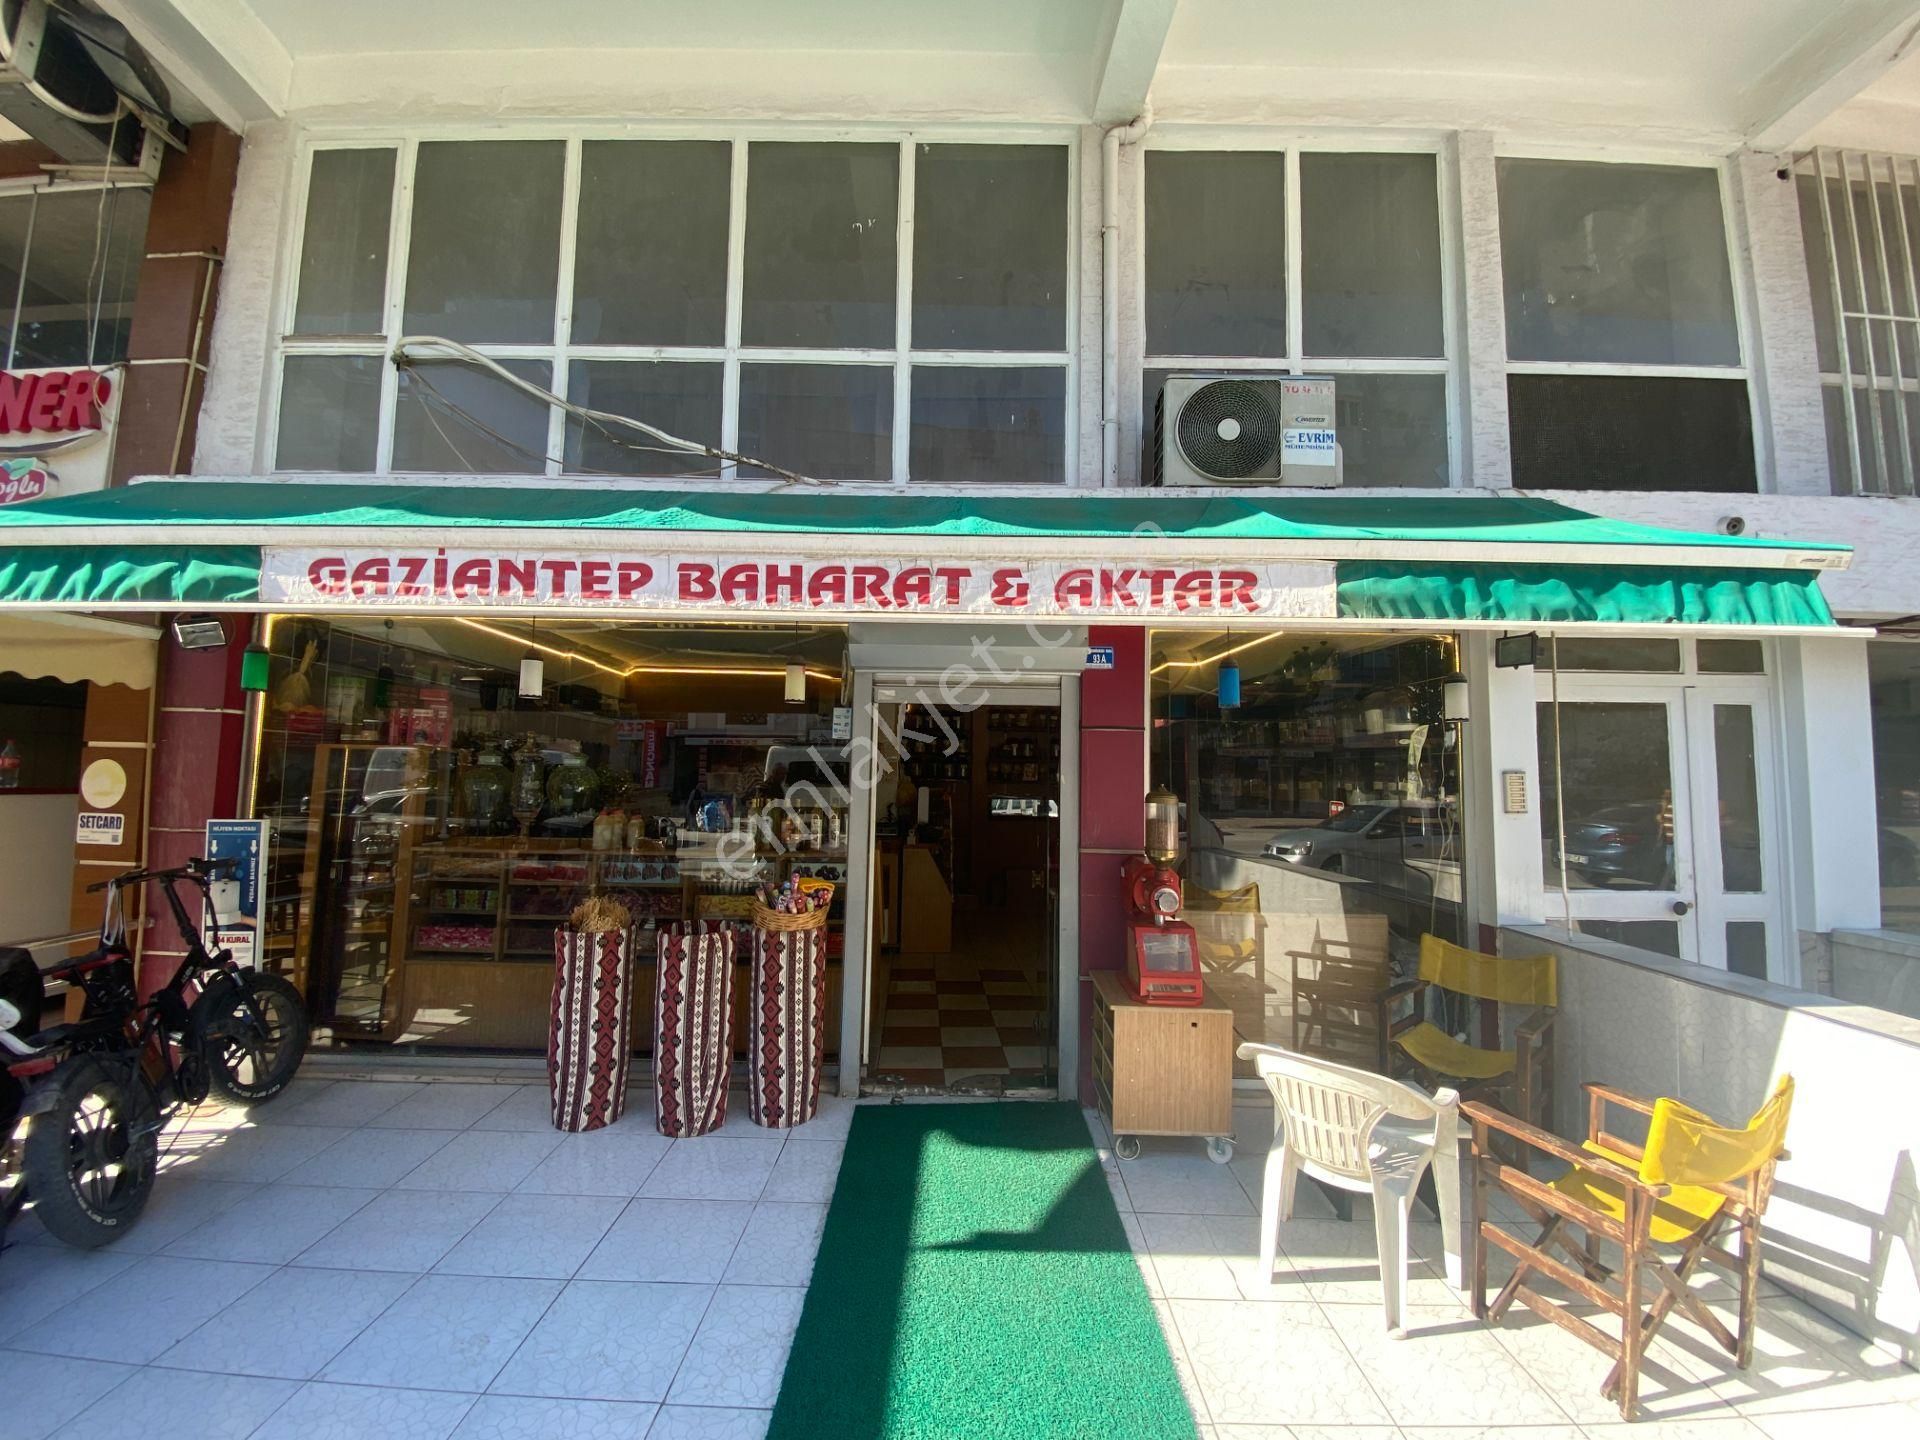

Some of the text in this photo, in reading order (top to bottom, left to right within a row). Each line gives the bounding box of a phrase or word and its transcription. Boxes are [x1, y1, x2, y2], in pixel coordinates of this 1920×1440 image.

[1298, 429, 1334, 444] EVRİM
[308, 548, 1260, 612] GAZİANTEP BAHARAT & AKTAR
[79, 815, 122, 830] SETCARD
[226, 936, 251, 944] KURAL
